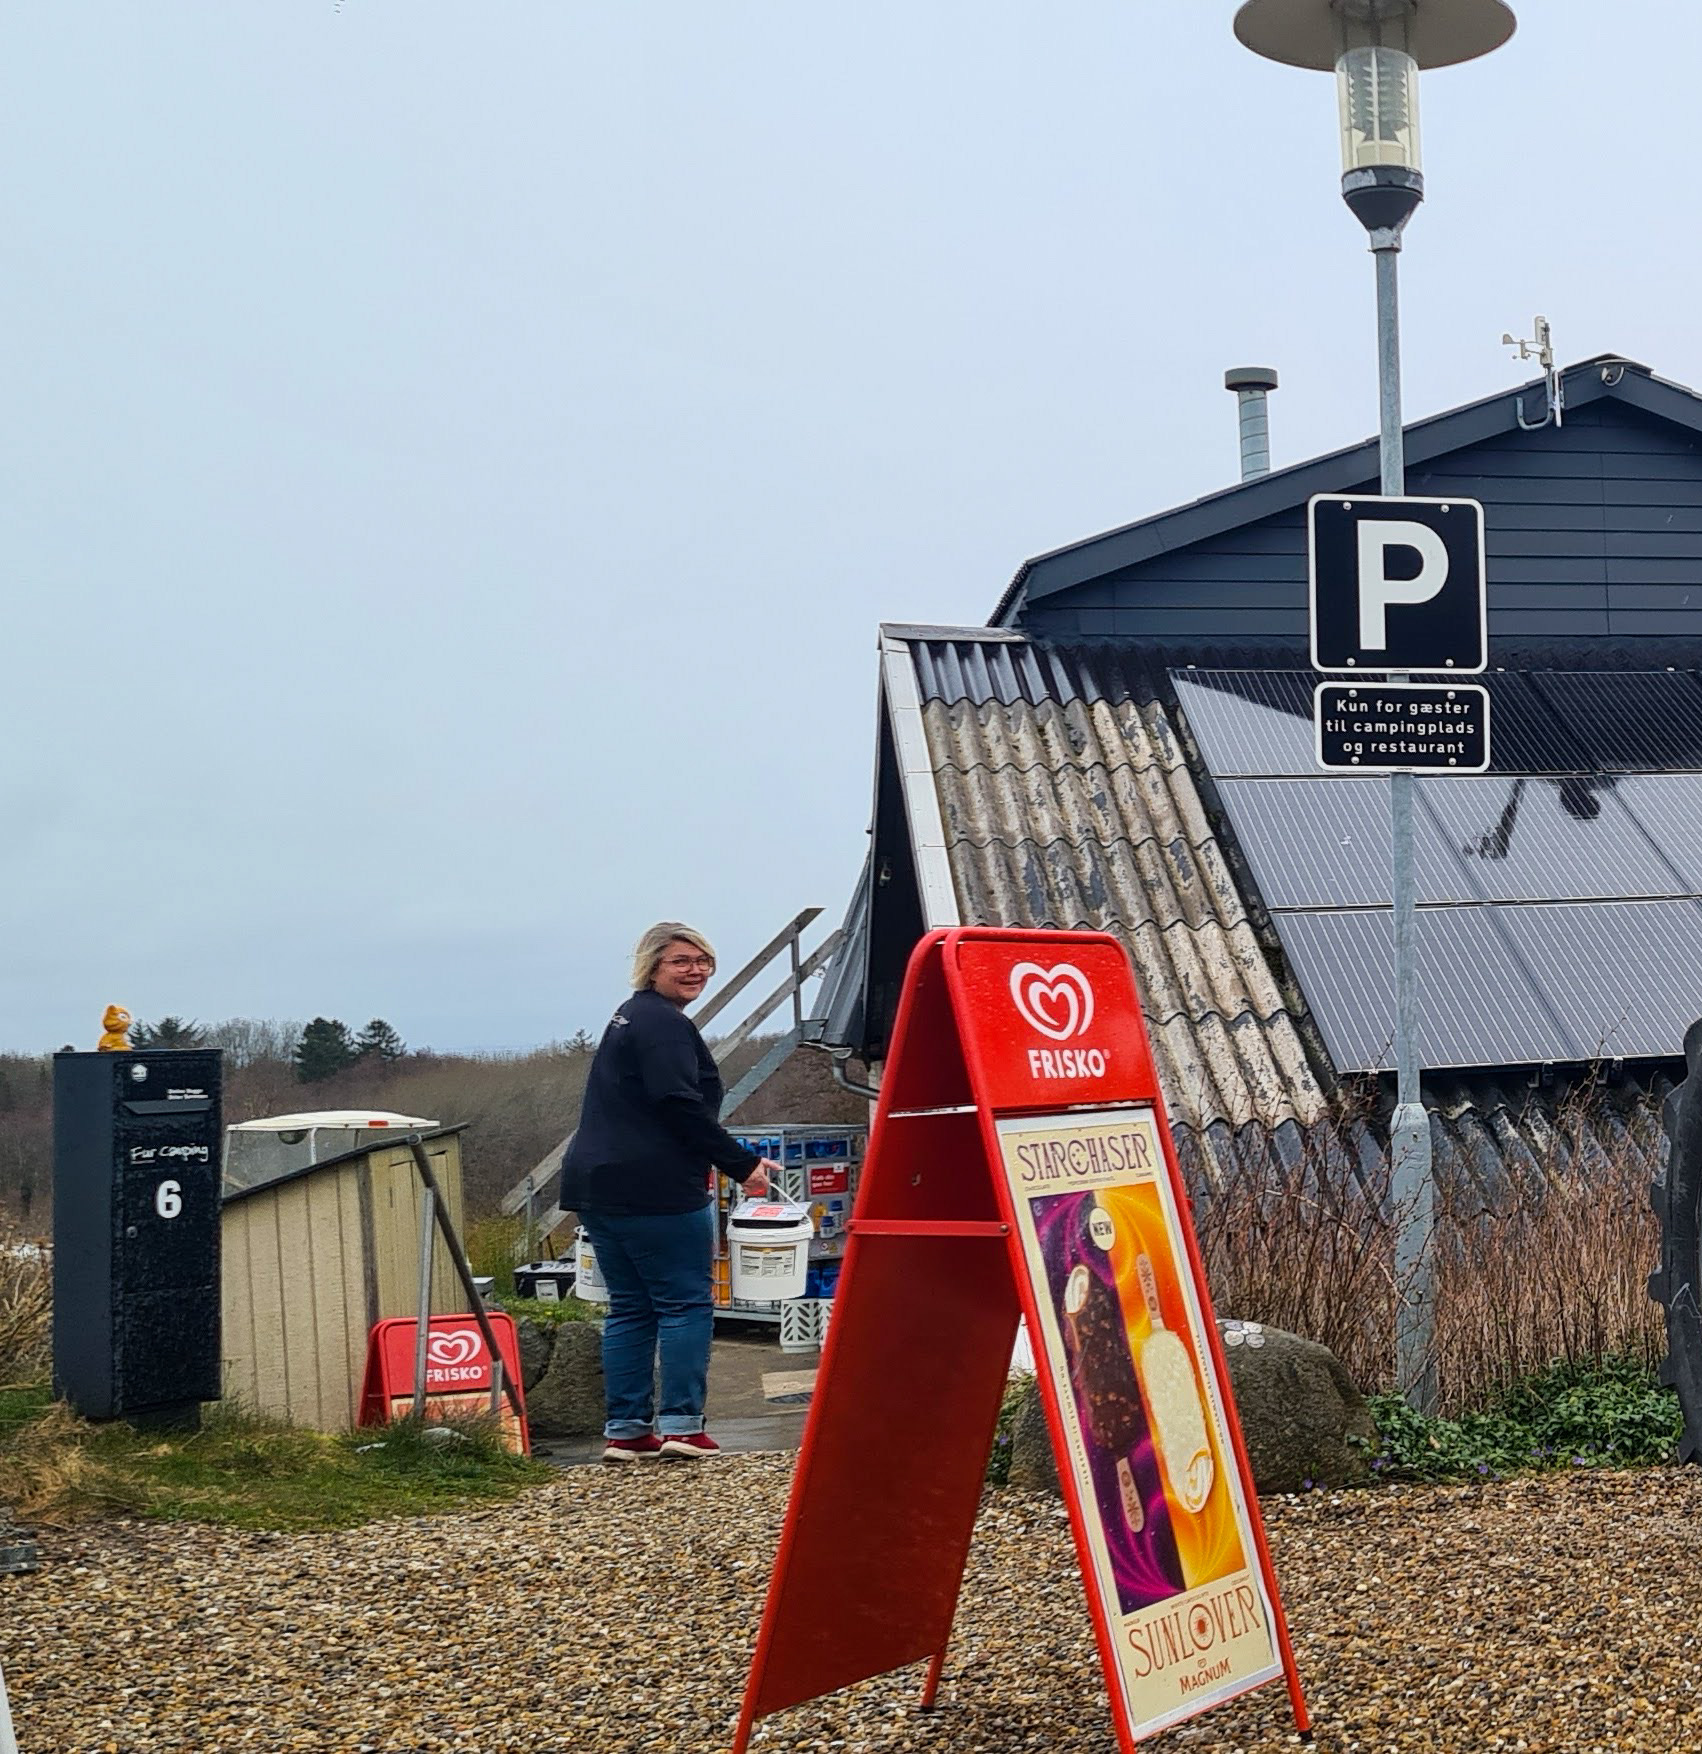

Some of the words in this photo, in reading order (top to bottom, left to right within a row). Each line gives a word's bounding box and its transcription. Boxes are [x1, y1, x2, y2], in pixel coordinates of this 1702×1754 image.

[1357, 520, 1449, 650] P
[1336, 699, 1369, 713] Kun
[1376, 700, 1402, 713] for
[1409, 701, 1470, 716] gæster
[1325, 720, 1347, 733] til
[1353, 720, 1475, 736] campingplads
[1343, 742, 1363, 754] og
[1371, 741, 1465, 754] restaurant
[1027, 1048, 1106, 1080] FRISKO
[1017, 1133, 1152, 1182] STARCHASER
[156, 1180, 182, 1219] 6
[1092, 1221, 1112, 1237] NEW
[426, 1366, 483, 1384] FRISKO
[1128, 1585, 1261, 1679] SUNLOVER
[1179, 1657, 1232, 1695] MAGNUM
